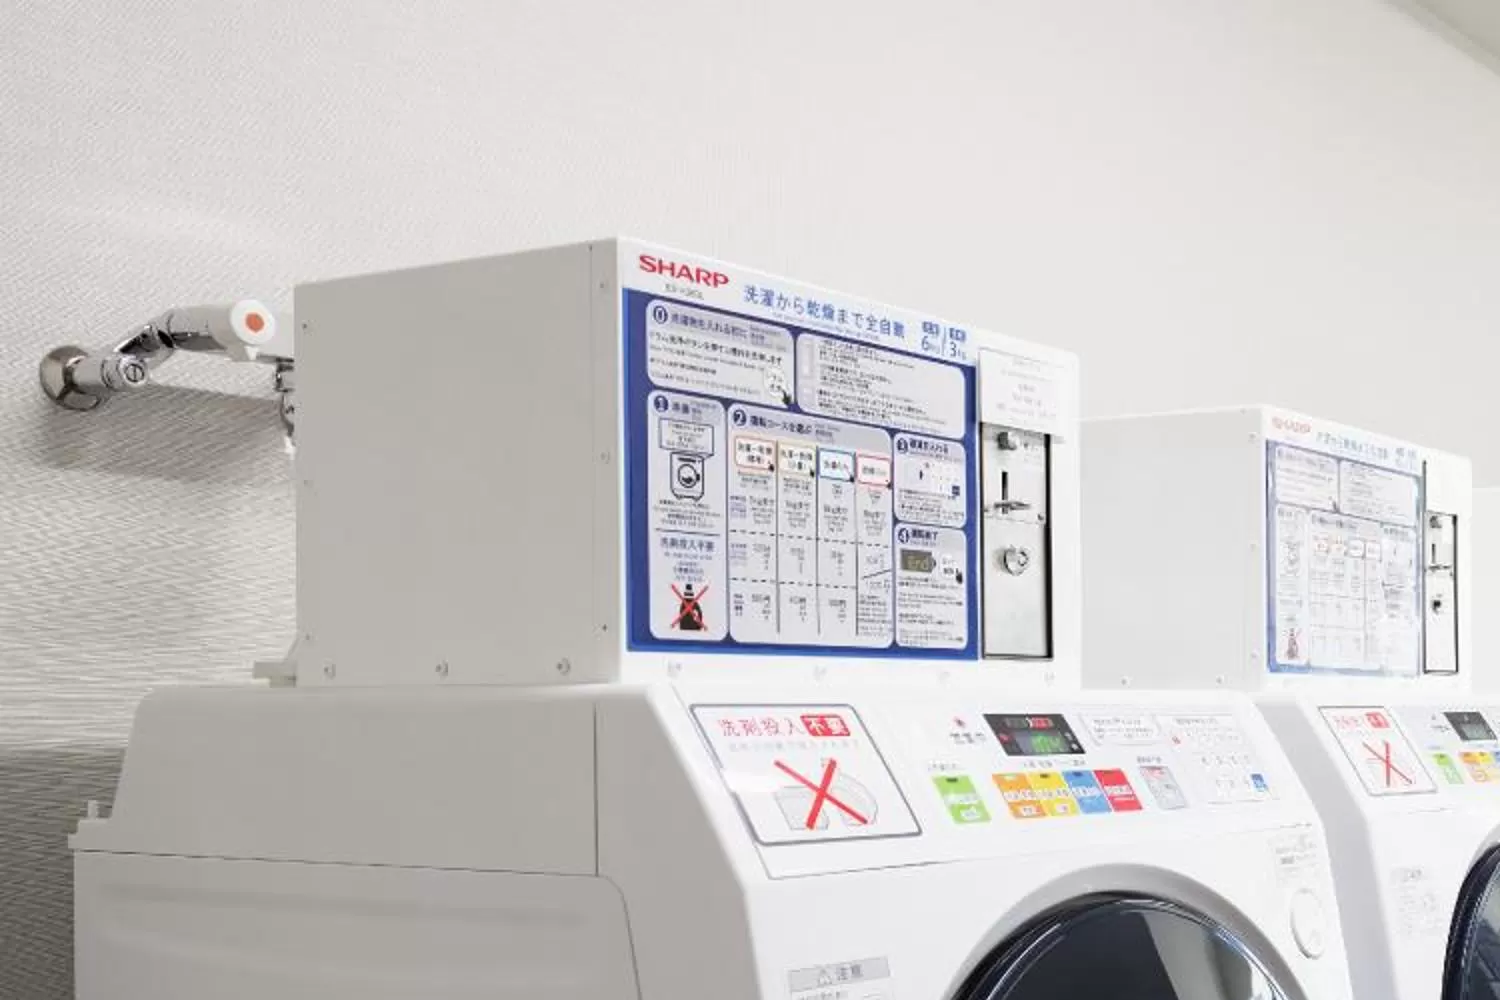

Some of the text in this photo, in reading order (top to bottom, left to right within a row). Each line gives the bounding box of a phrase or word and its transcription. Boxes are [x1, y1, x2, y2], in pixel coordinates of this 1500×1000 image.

[638, 254, 729, 288] SHARP
[743, 283, 906, 339] 洗濯から乾燥まで全自動
